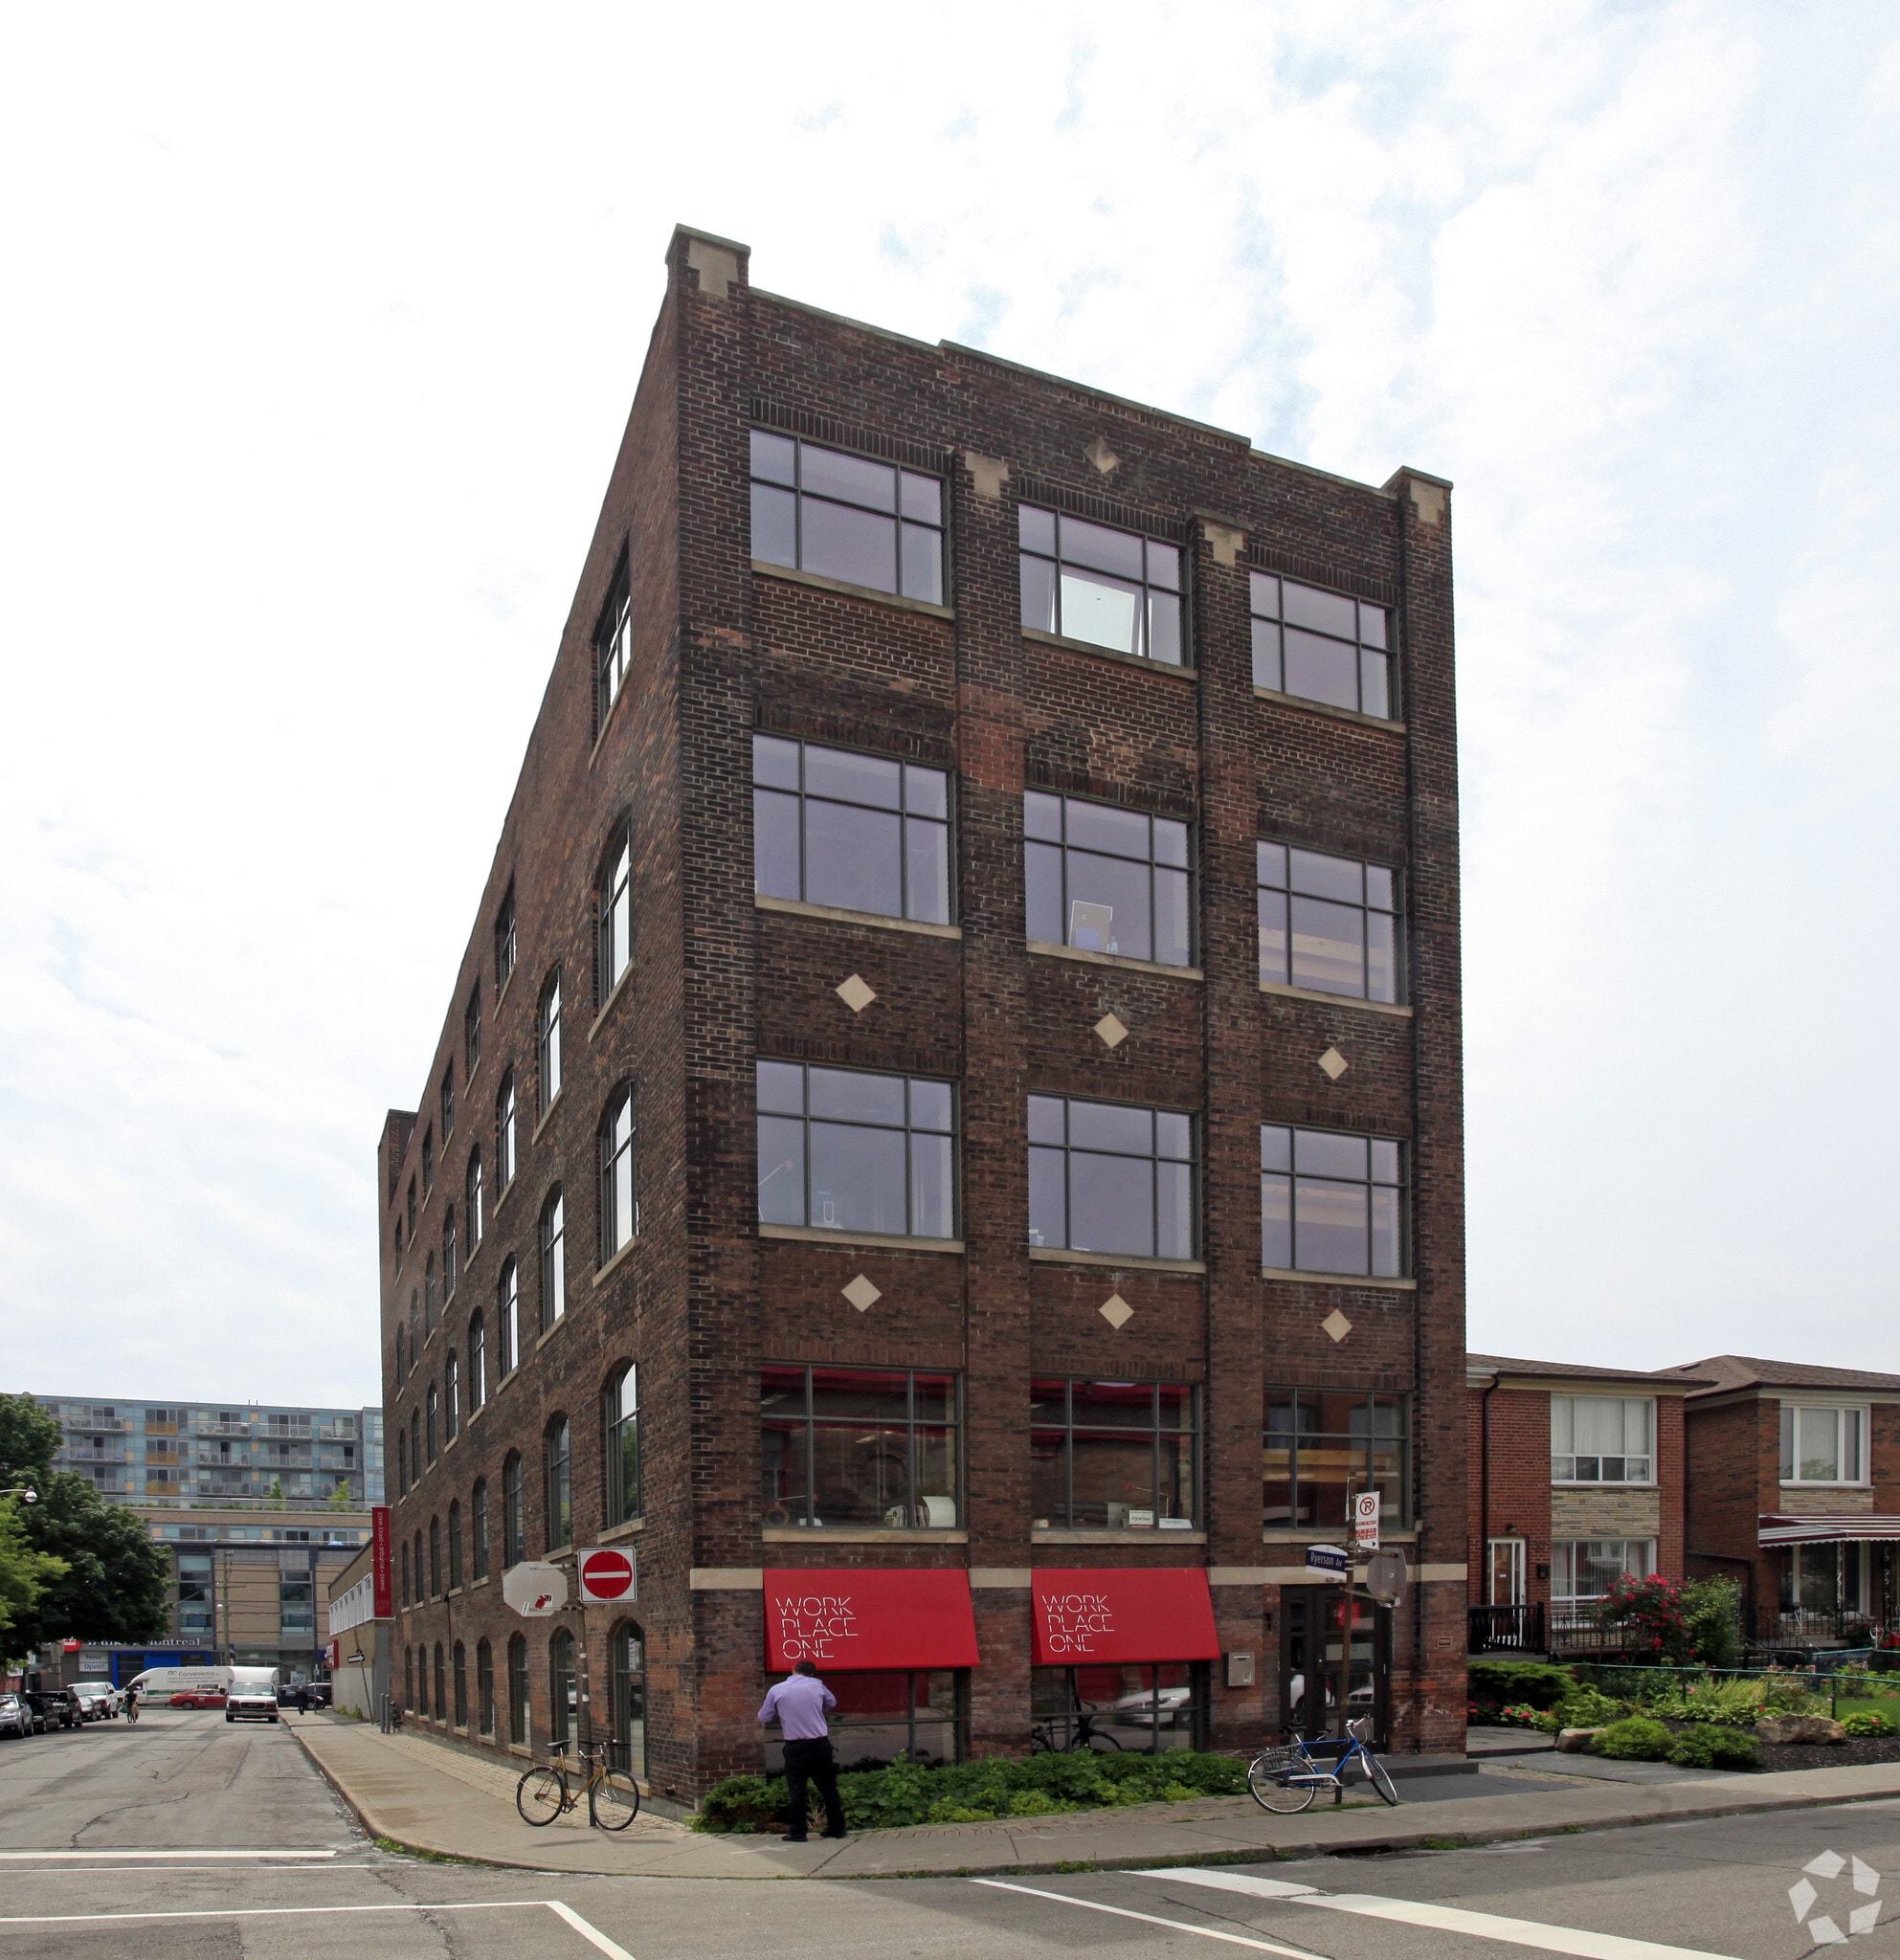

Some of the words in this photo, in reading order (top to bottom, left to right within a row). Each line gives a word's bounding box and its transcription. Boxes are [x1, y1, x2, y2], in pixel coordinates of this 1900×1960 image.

[1310, 1551, 1334, 1566] Ryerson
[1335, 1558, 1343, 1568] Av
[775, 1596, 854, 1616] WORK
[1041, 1594, 1110, 1613] WORK
[781, 1617, 859, 1637] PLACE
[1047, 1614, 1115, 1633] PLACE
[782, 1638, 835, 1659] ONE
[1049, 1634, 1095, 1653] ONE
